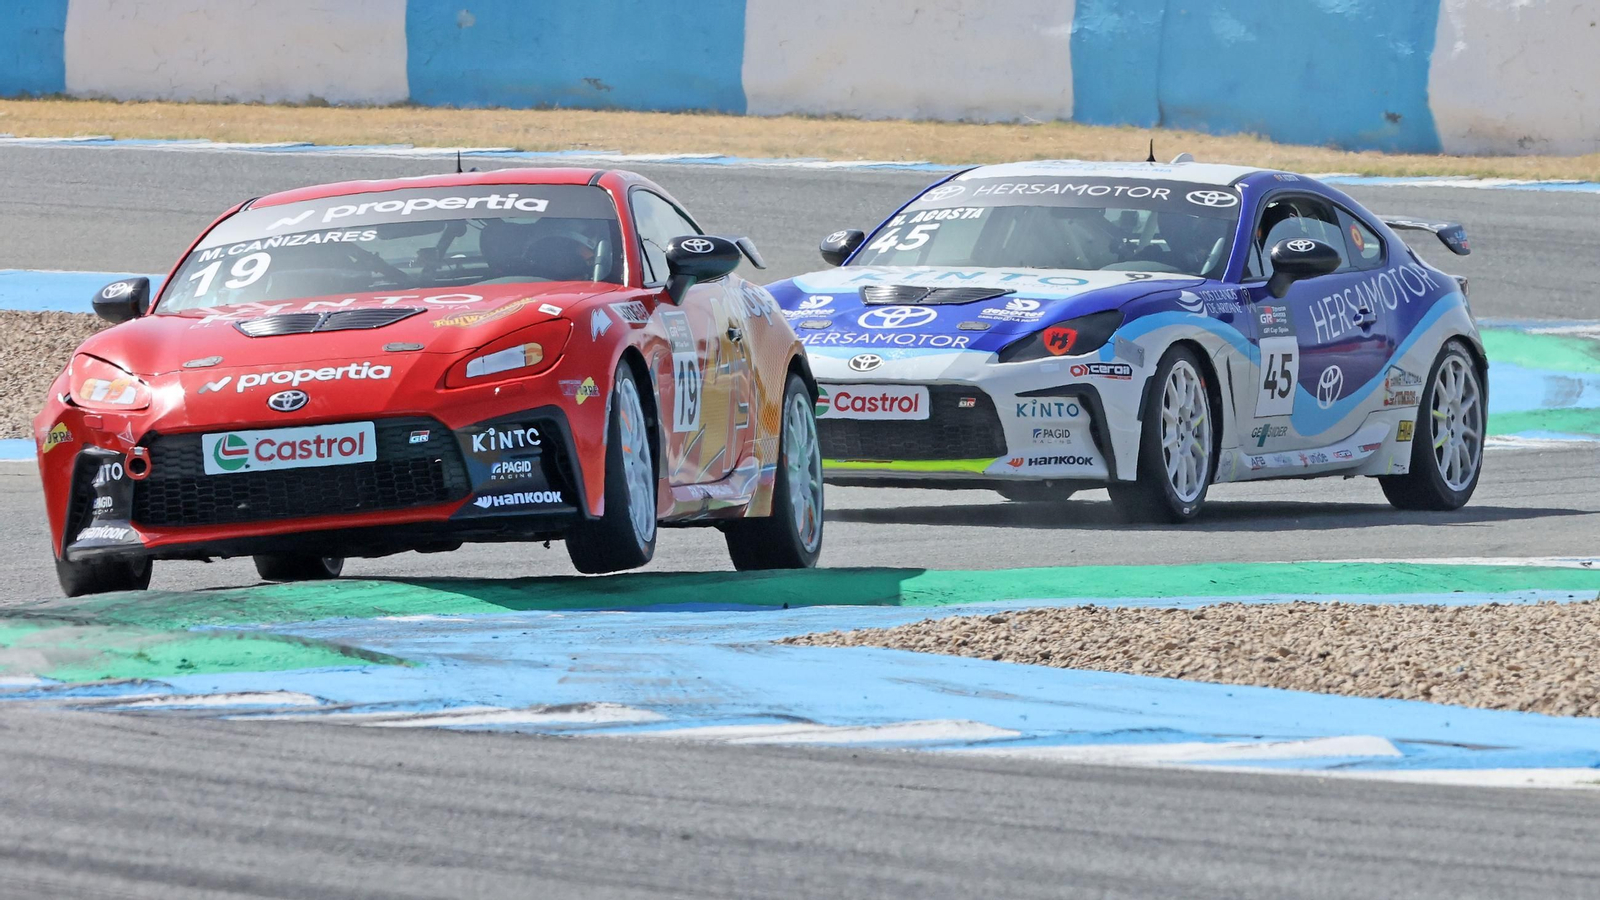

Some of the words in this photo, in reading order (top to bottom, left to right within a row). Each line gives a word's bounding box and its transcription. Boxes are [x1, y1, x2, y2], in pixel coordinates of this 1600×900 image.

[974, 183, 1171, 200] HERSAMOTOR
[322, 194, 549, 223] propertia
[909, 207, 985, 223] ACOSTA
[868, 223, 940, 254] 45
[189, 252, 272, 298] 19
[1309, 262, 1440, 344] HERSAMOTOR
[1260, 314, 1273, 324] GR
[798, 332, 970, 348] HERSAMOTOR
[236, 362, 392, 392] propertia
[1263, 353, 1293, 400] 45
[678, 359, 698, 426] 19
[834, 391, 920, 413] Castrol
[255, 431, 365, 462] Castrol
[1043, 429, 1071, 439] PAGID
[502, 461, 531, 474] PAGID
